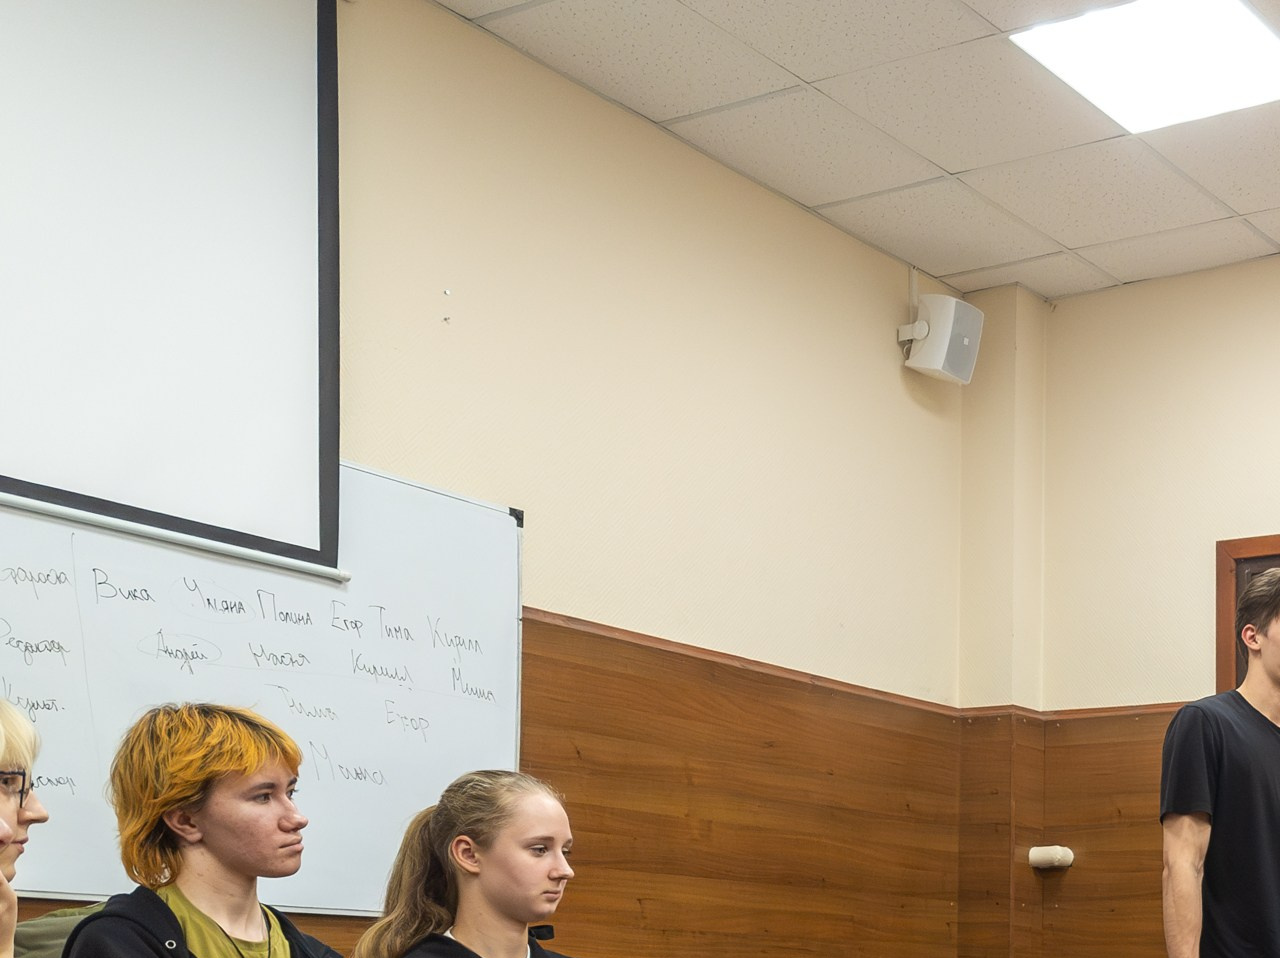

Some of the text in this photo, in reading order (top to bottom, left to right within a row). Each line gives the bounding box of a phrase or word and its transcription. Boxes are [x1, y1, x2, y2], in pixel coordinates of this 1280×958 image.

[92, 568, 156, 604] Вика
[257, 589, 312, 626] Полина
[332, 600, 363, 638] Егор
[369, 605, 414, 641] Тима
[427, 615, 483, 658] Кирилл
[156, 629, 496, 702] Андрей Настя Кирилл Миша
[385, 699, 429, 742] Егор
